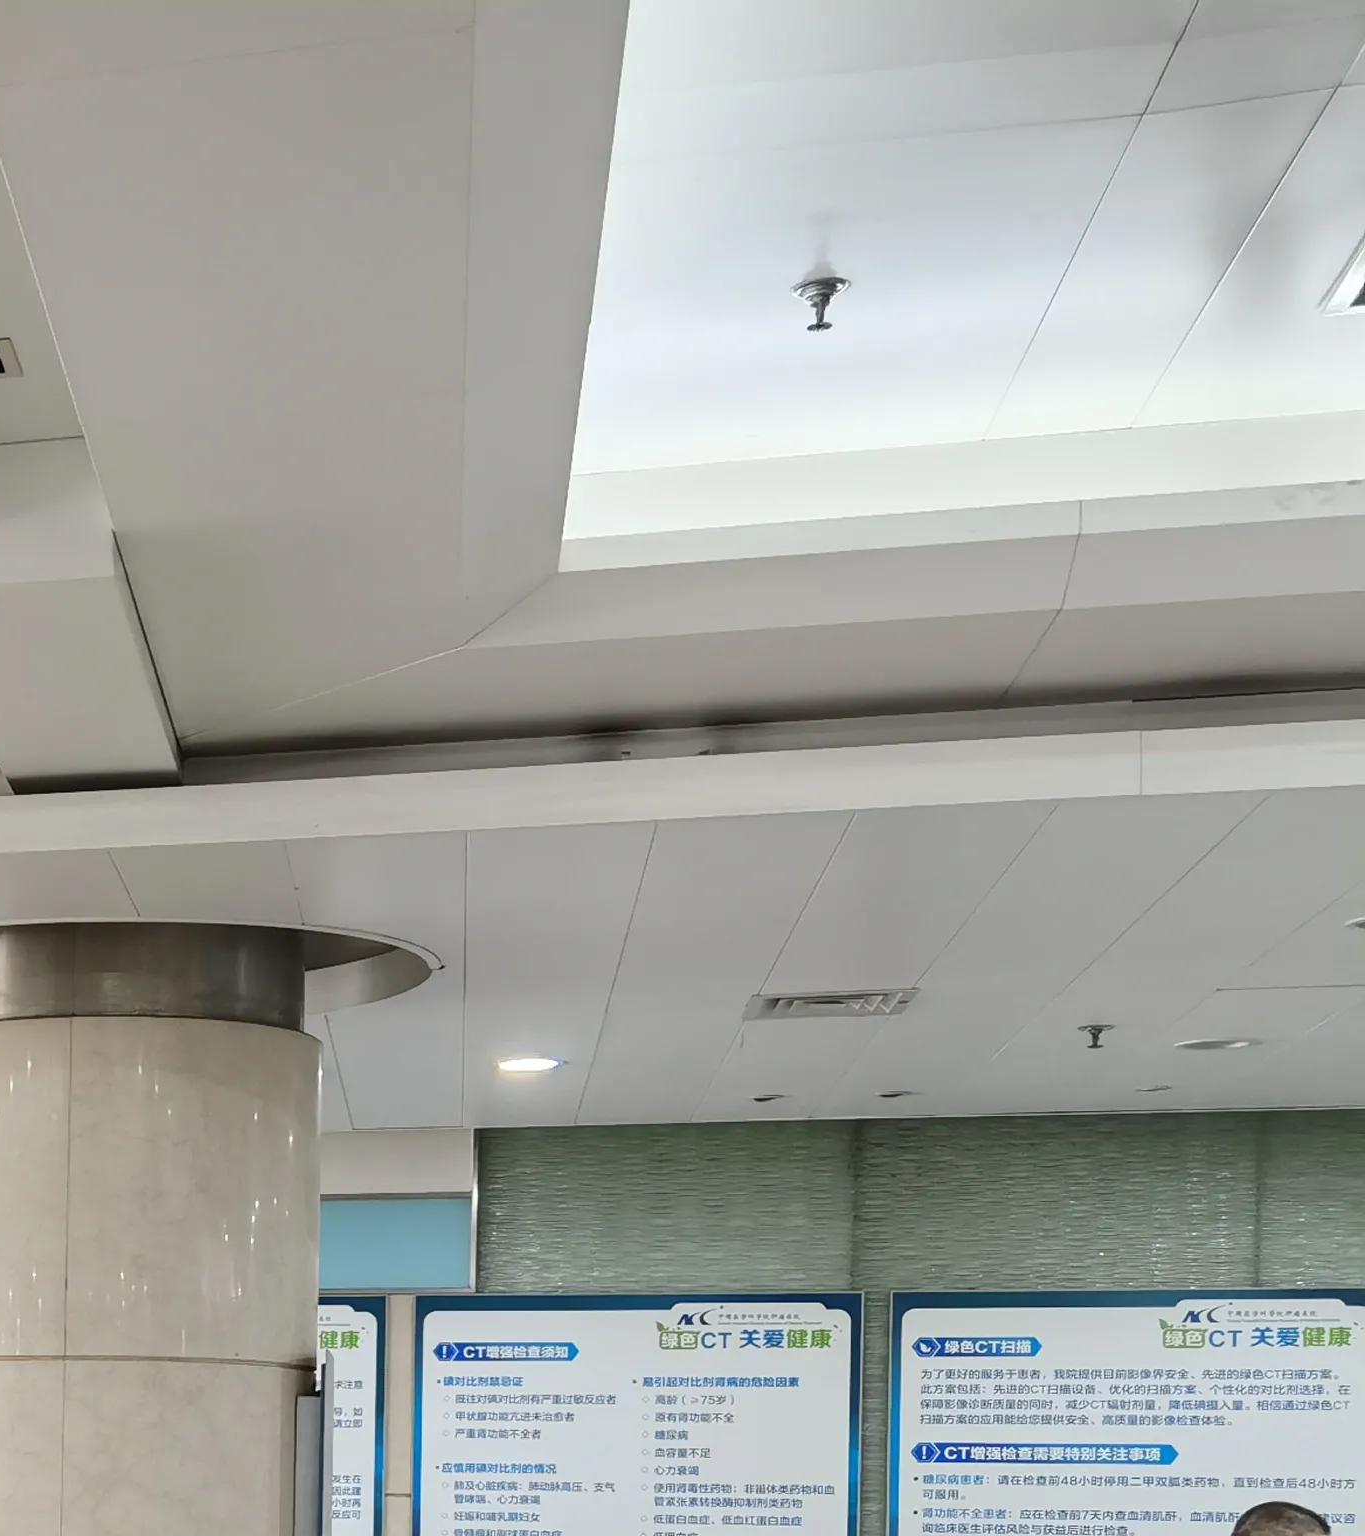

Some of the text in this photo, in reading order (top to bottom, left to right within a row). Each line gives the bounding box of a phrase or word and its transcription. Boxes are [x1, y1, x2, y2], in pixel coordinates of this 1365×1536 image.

[739, 1329, 833, 1349] 关爱健康
[1250, 1327, 1352, 1347] 关爱健康
[463, 1345, 569, 1359] CT增强检查须知
[944, 1340, 1032, 1354] 绿色CT扫描
[654, 1430, 689, 1441] 糖尿病
[654, 1448, 711, 1458] 血容量不足
[944, 1446, 1161, 1462] CT增强检查需要特别关注事项
